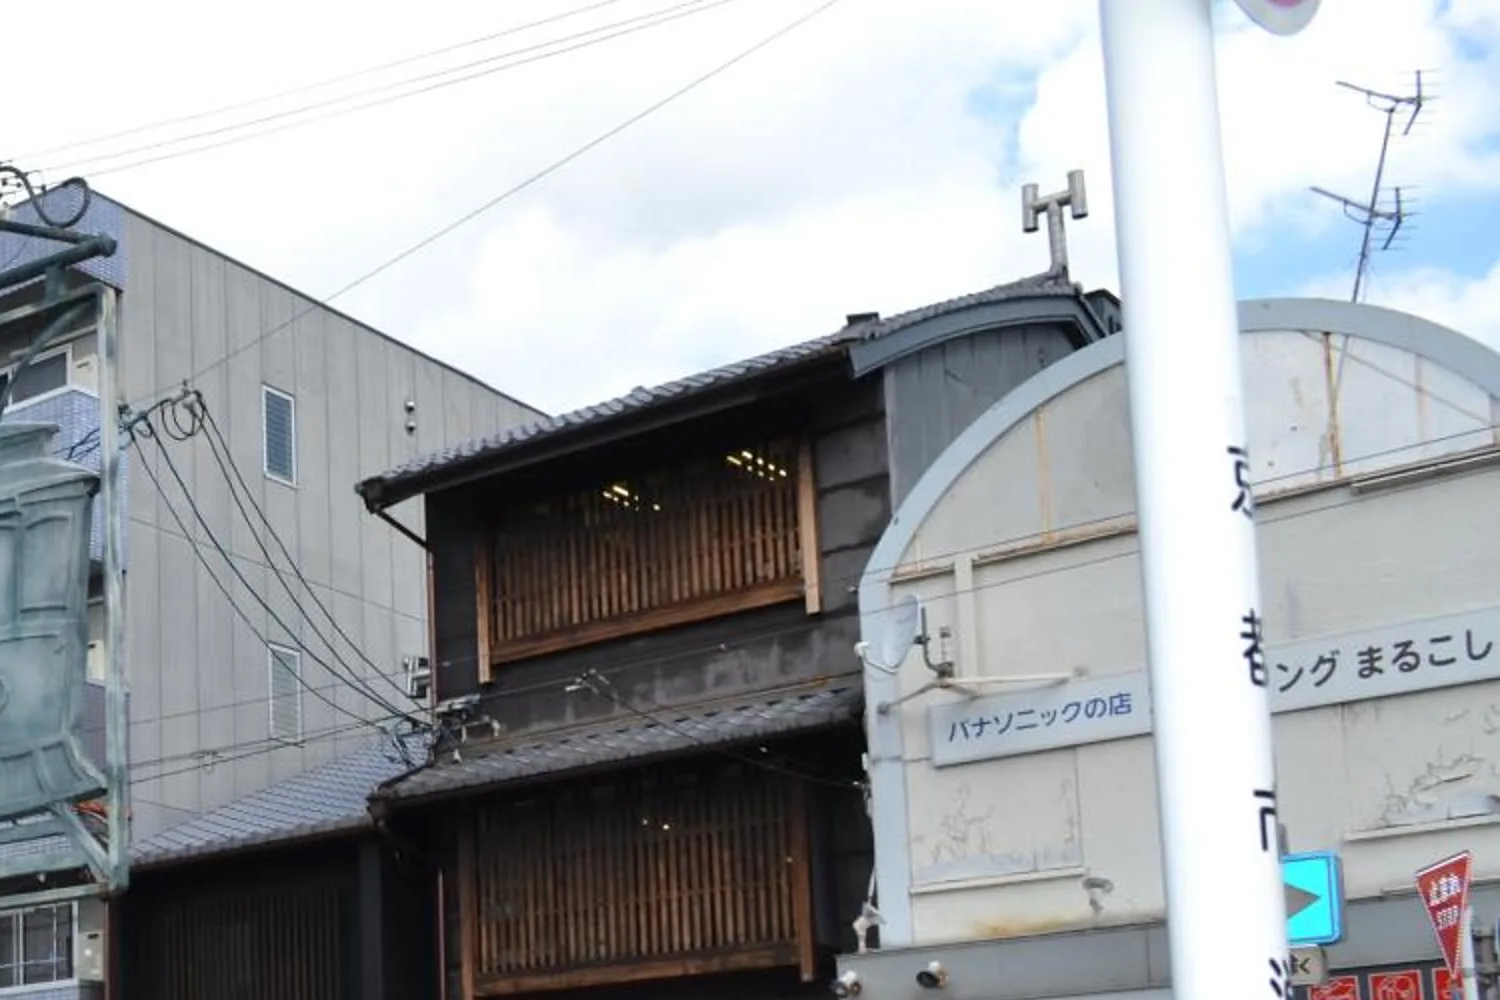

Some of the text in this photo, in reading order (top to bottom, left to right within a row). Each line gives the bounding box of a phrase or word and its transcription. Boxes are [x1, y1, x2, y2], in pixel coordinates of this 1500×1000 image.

[1357, 629, 1493, 679] まるこし
[948, 692, 1133, 743] パナソニックの店
